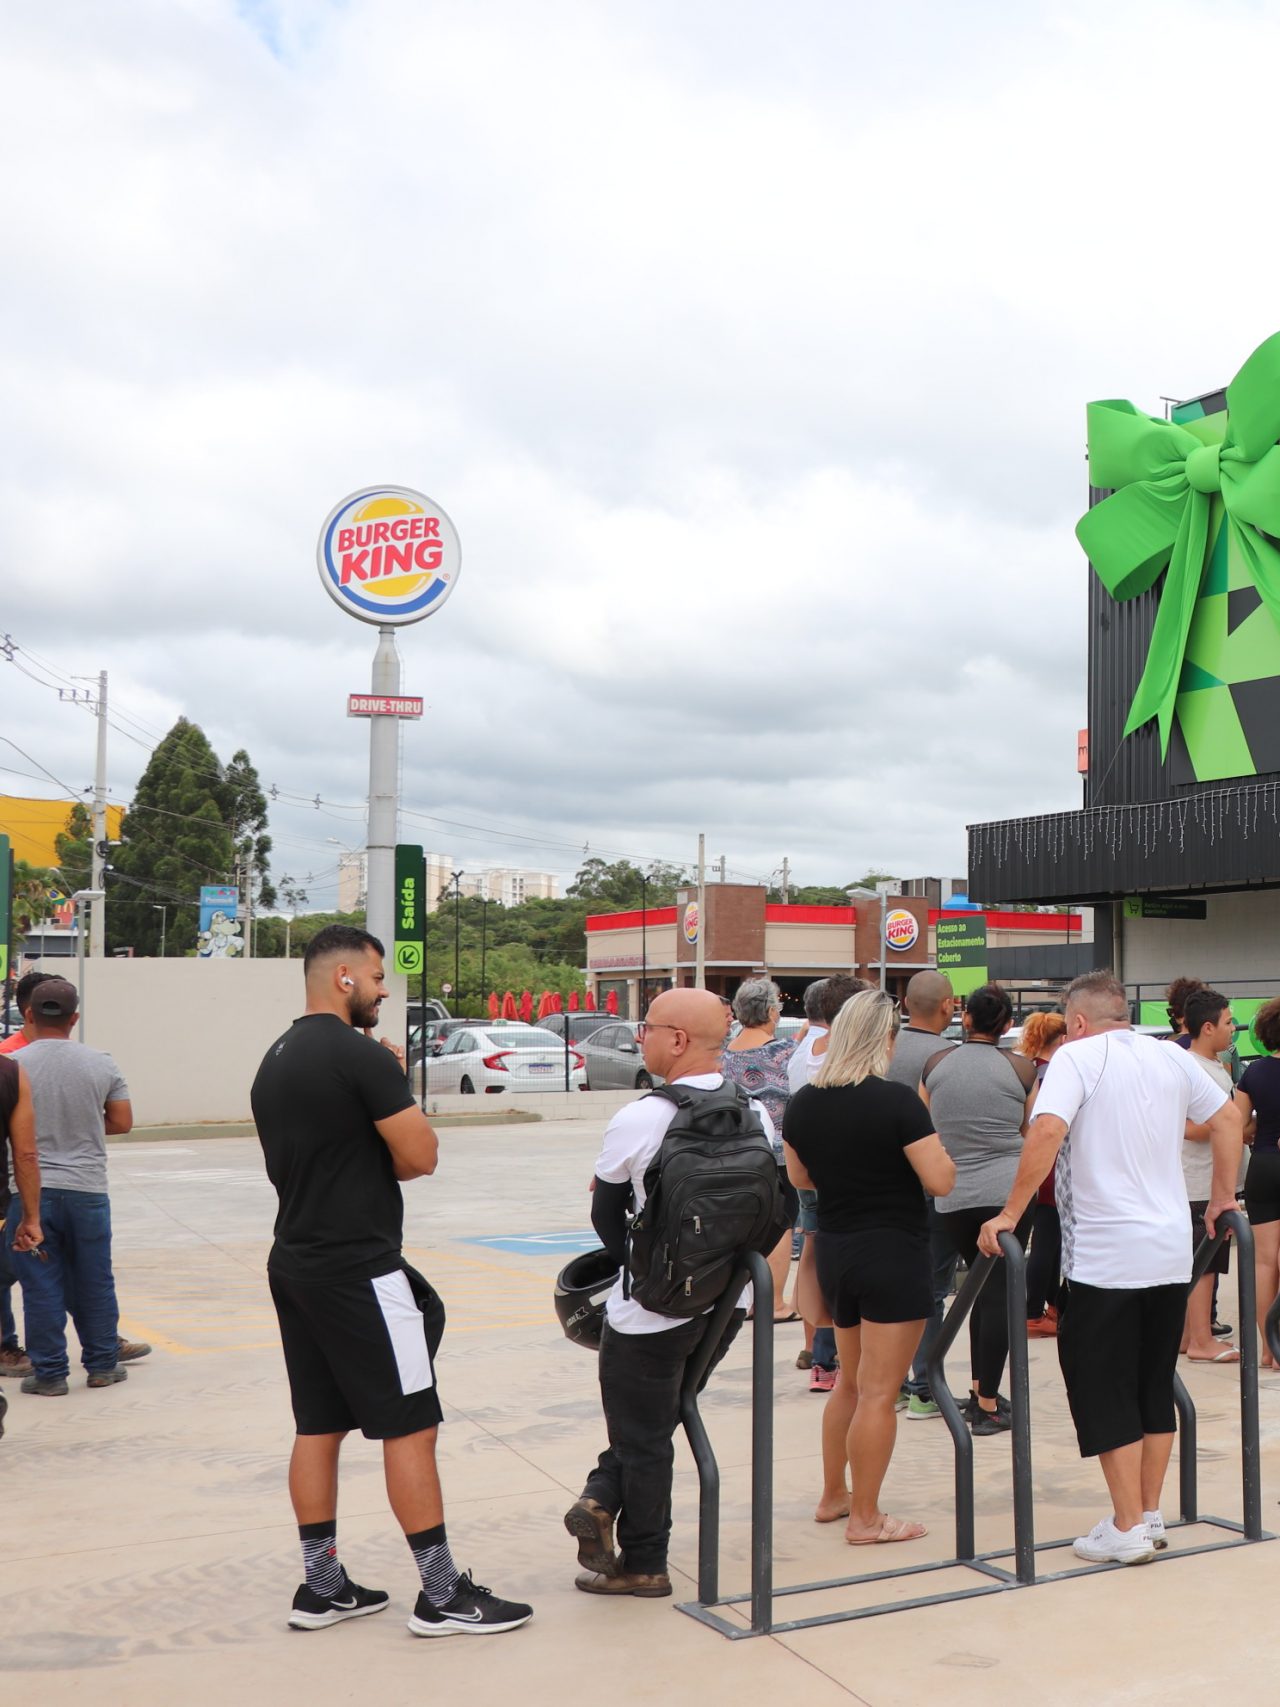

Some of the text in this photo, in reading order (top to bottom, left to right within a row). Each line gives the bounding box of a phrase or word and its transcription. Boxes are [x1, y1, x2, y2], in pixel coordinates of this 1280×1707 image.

[338, 517, 440, 553] BURGER
[340, 539, 443, 585] KING
[350, 698, 421, 714] DRIVE-THRU
[401, 877, 415, 929] Saída
[887, 918, 913, 930] BURGER
[937, 923, 967, 934] Acesso ao
[886, 926, 914, 939] KING
[937, 936, 985, 949] Estacionamento
[938, 953, 961, 963] Coberto
